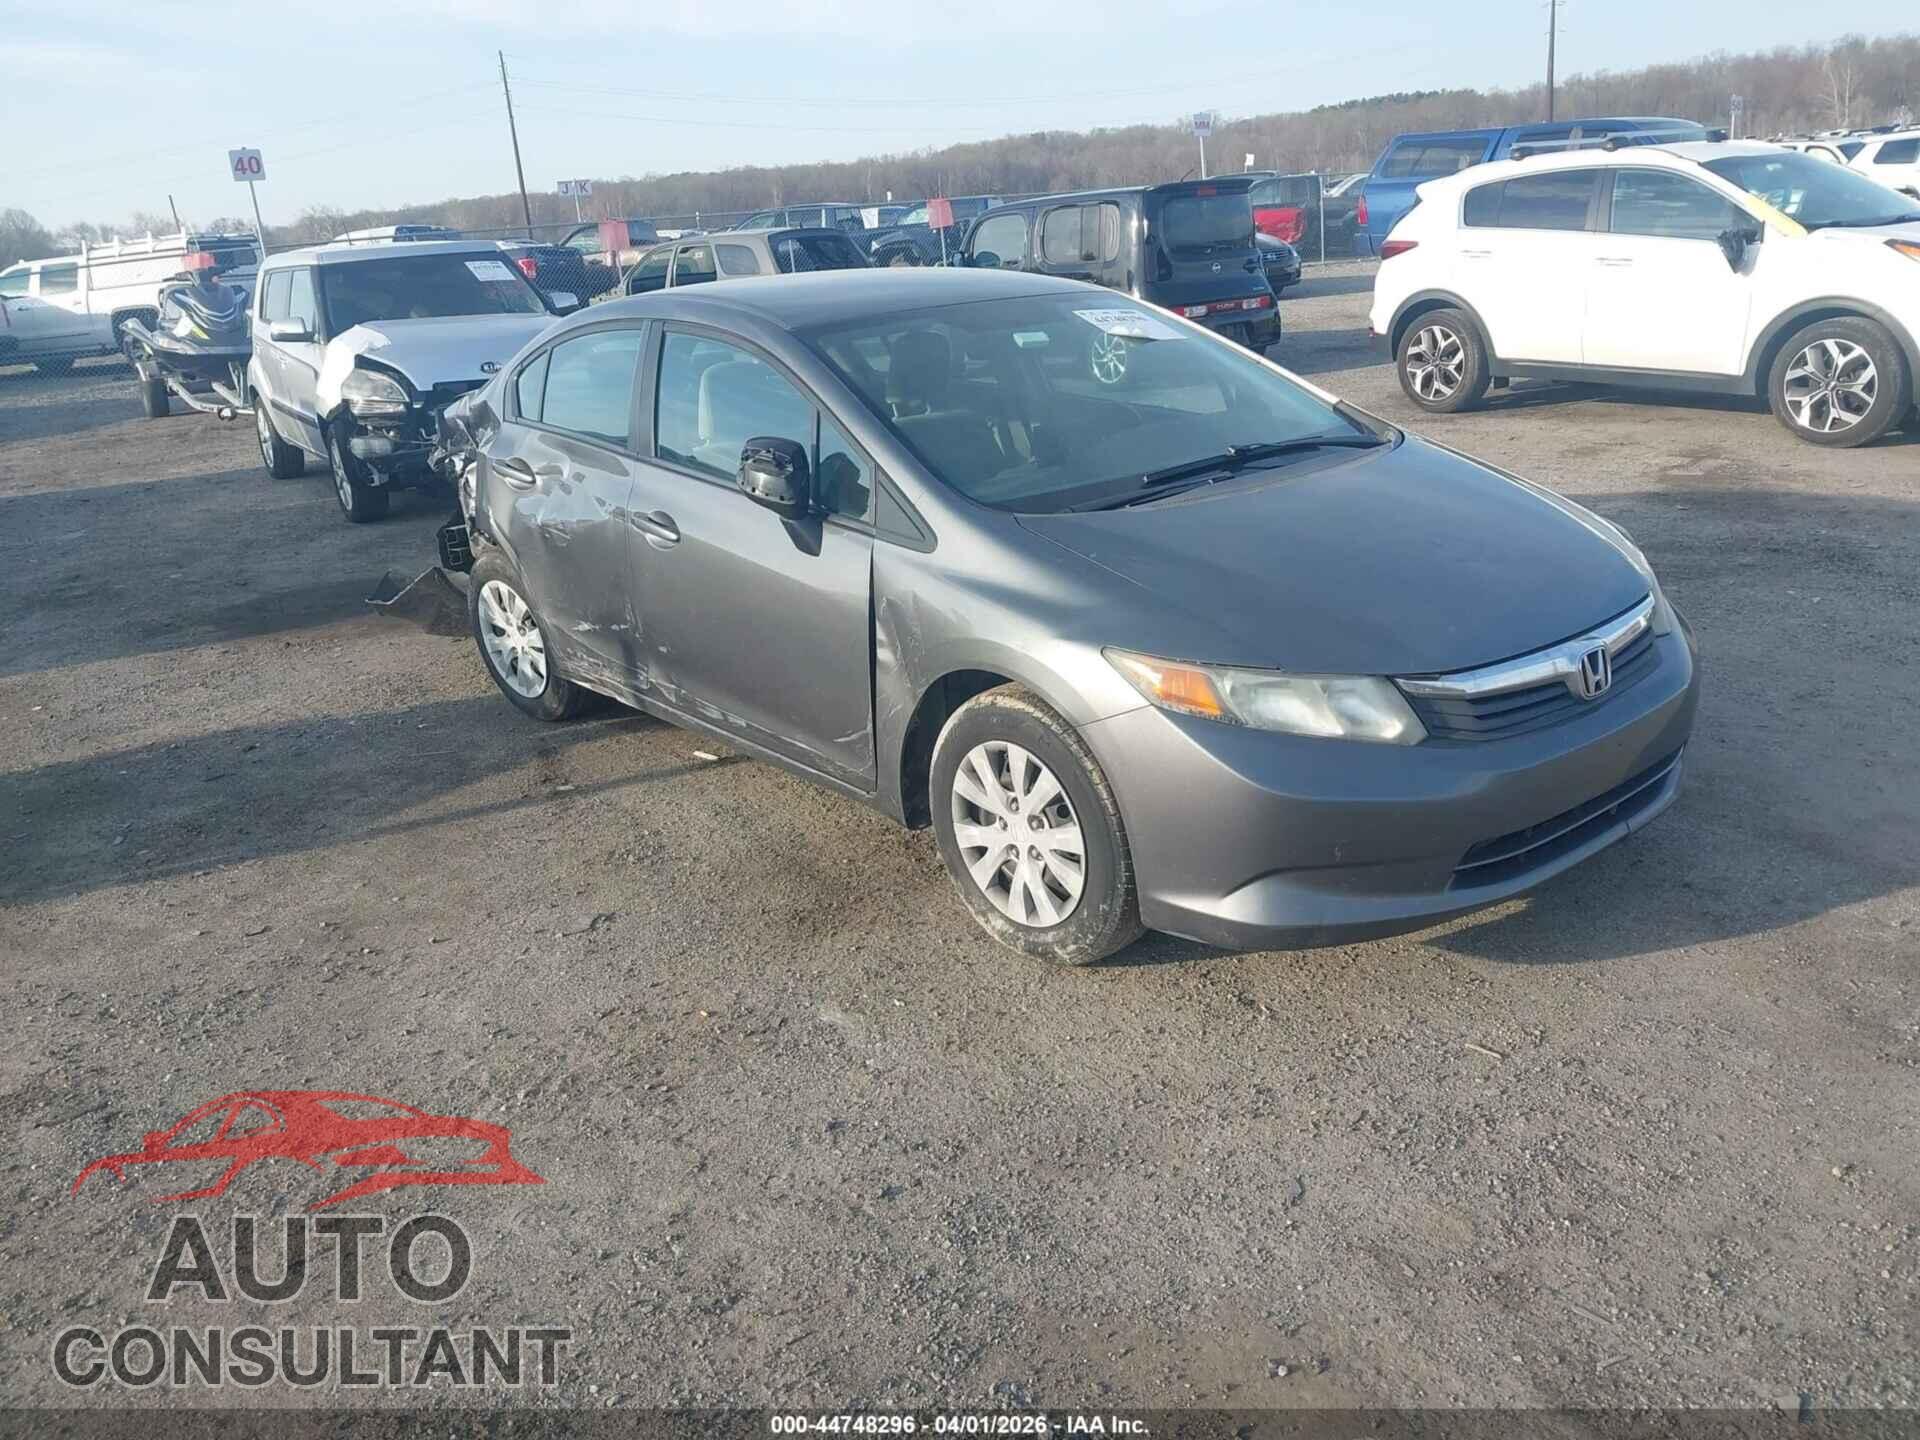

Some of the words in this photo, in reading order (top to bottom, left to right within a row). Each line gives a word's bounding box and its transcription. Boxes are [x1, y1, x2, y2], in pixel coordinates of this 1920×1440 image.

[234, 155, 262, 175] 40
[562, 183, 569, 194] J
[579, 182, 588, 193] K
